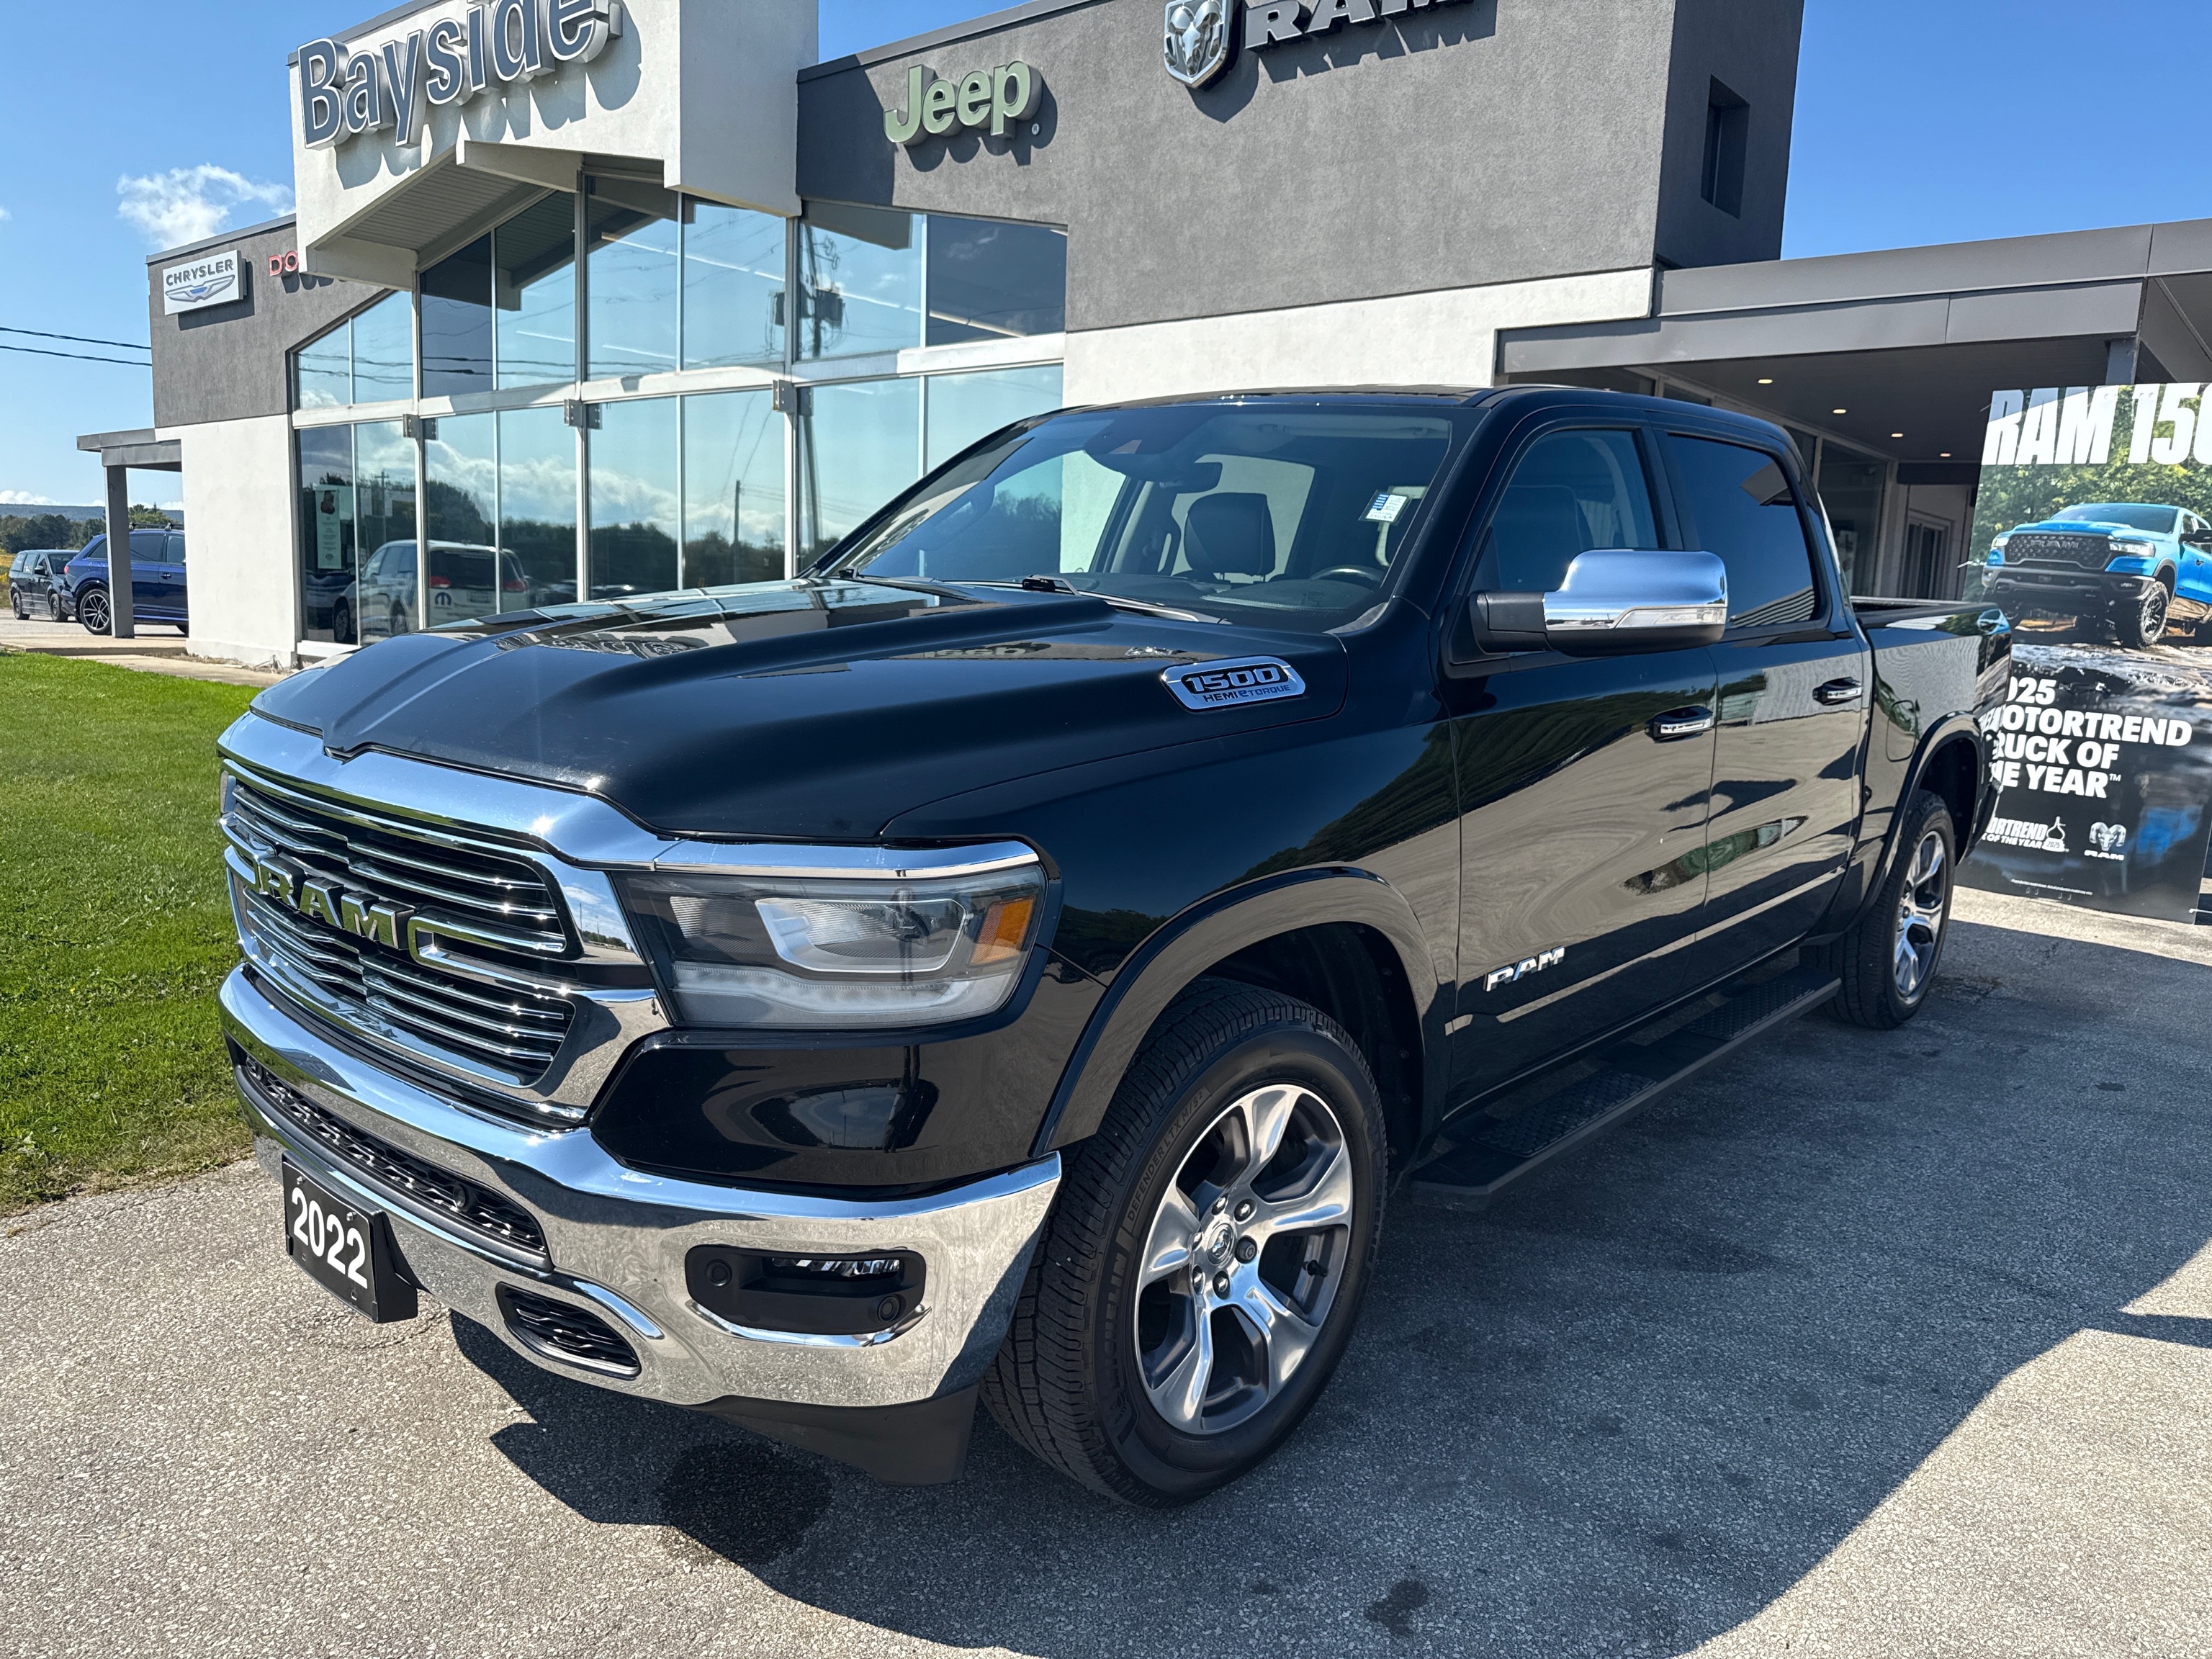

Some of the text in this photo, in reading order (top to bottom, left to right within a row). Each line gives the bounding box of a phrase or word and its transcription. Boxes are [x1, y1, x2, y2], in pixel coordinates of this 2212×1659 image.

[1245, 0, 1446, 49] RA
[297, 0, 612, 149] Bayside
[883, 60, 1031, 144] Jeep
[166, 258, 234, 287] CHRYSLER
[1981, 385, 2120, 466] RAM
[2029, 539, 2080, 549] RAM
[1186, 666, 1281, 693] 1500
[1202, 689, 1238, 703] HEMI
[2000, 703, 2193, 747] OTORTREND
[2076, 740, 2121, 770] OF
[2000, 836, 2018, 845] THE
[2017, 838, 2044, 849] YEAR
[2084, 849, 2125, 861] RAM
[259, 855, 414, 950] RAM
[1483, 945, 1565, 992] RAM
[1128, 1147, 1165, 1223] DEFENDER
[1163, 1120, 1182, 1148] LTX
[292, 1187, 368, 1290] 2022
